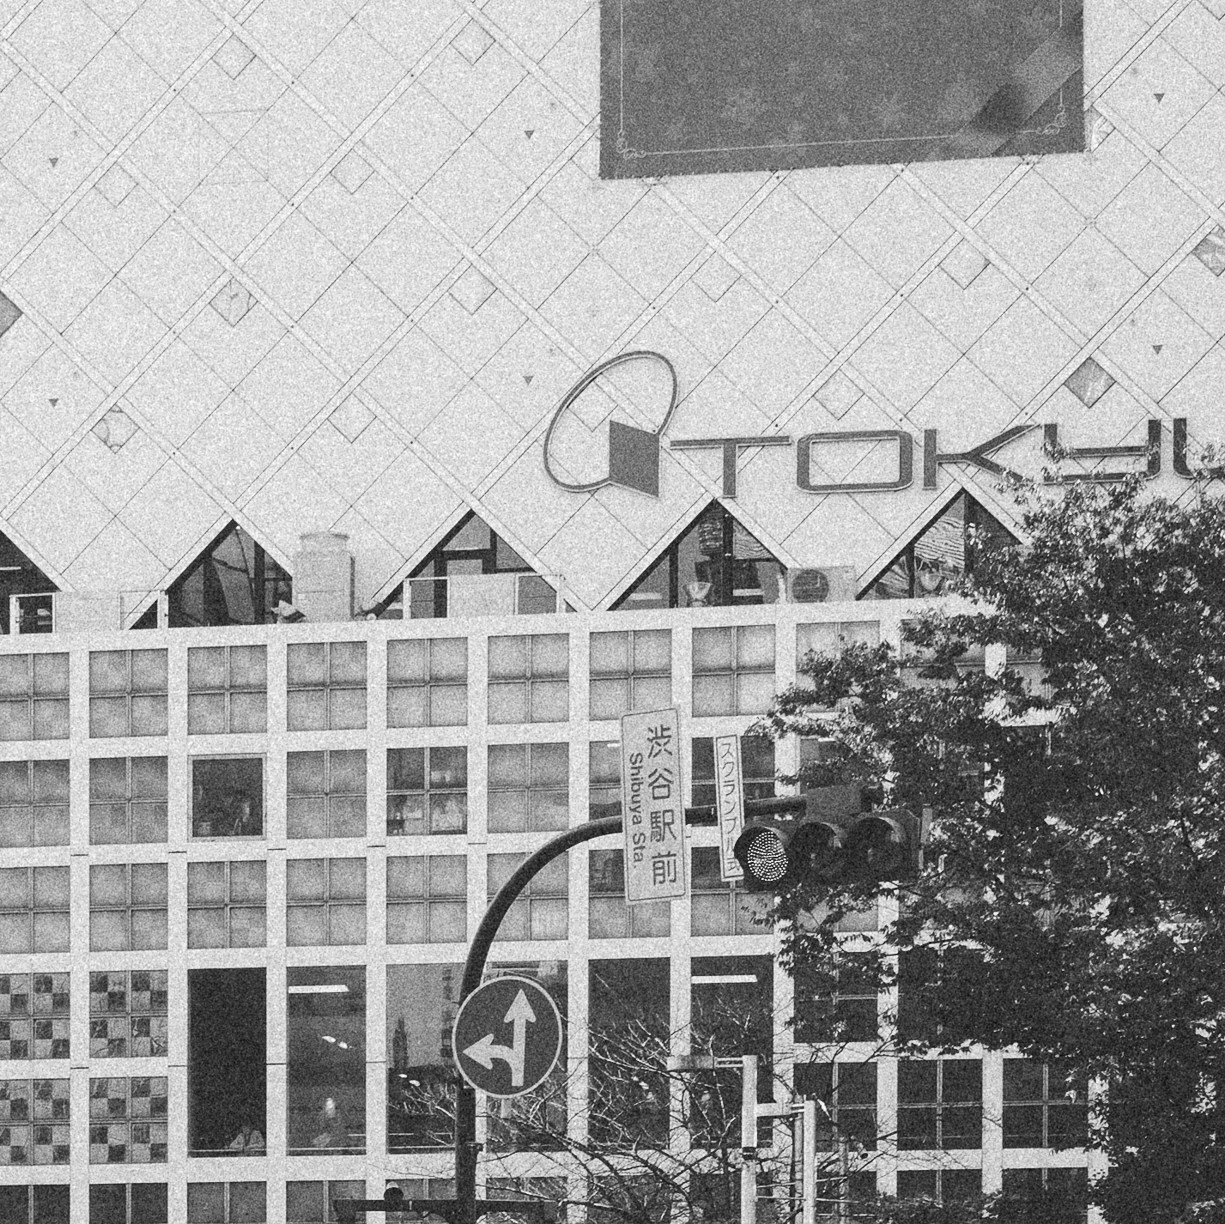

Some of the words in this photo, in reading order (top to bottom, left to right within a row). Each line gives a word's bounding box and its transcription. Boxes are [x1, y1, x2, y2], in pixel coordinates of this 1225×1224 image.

[629, 752, 645, 826] Shibuya
[646, 724, 678, 887] 渋谷駅前
[632, 832, 647, 869] Sta.
